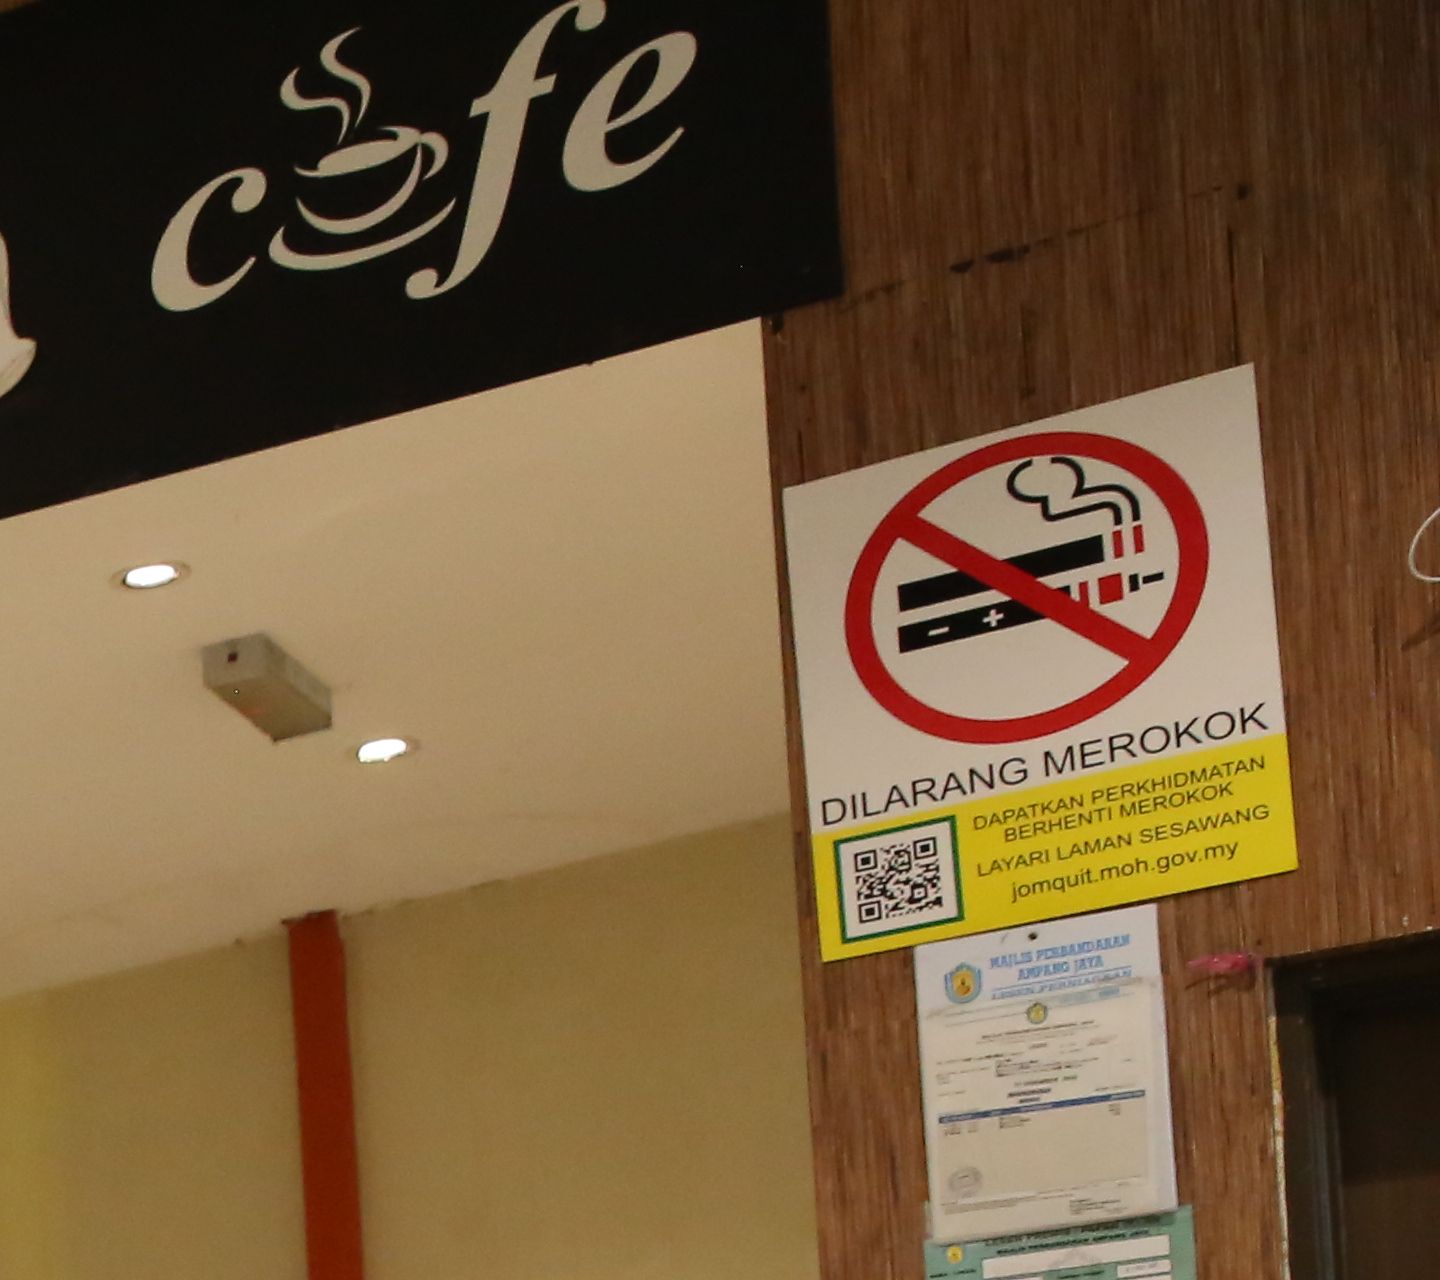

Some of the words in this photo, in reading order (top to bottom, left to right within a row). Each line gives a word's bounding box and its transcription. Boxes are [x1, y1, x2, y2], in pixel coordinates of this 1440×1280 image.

[822, 757, 1028, 825] DILARANG
[1044, 702, 1269, 777] MEROKOK
[973, 795, 1084, 830] DAPATKAN
[1092, 756, 1265, 805] PERKHIDMATAN
[977, 849, 1049, 877] LAYARI
[1058, 832, 1132, 861] LAMAN
[1140, 804, 1270, 845] SESAWANG
[1004, 807, 1113, 842] BERHENTI
[1119, 782, 1234, 816] MEROKOK
[1011, 841, 1239, 903] jomquit.moh.gov.my
